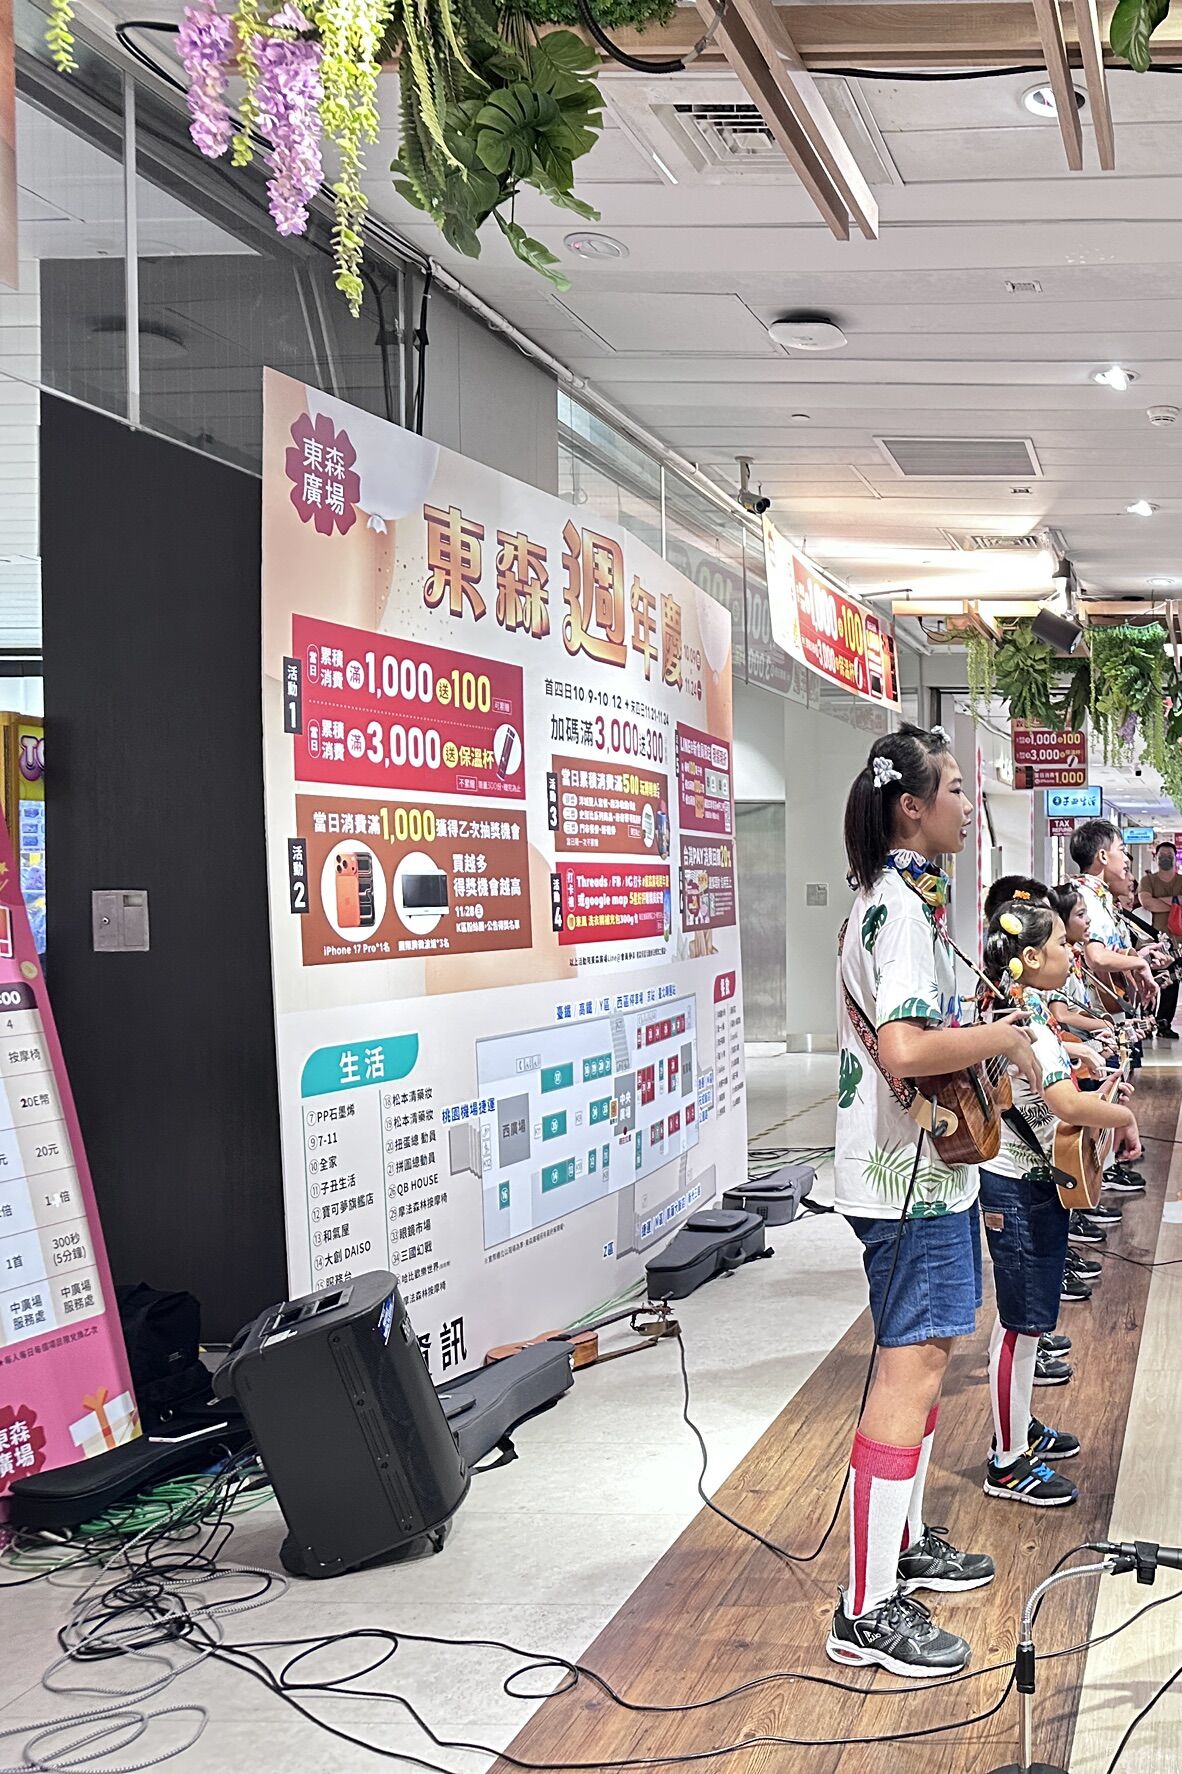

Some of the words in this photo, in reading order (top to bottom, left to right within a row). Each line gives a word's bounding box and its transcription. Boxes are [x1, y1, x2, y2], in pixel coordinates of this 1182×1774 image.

[303, 437, 346, 480] 東森
[302, 472, 345, 516] 廣場
[423, 502, 684, 693] 東森週年慶
[841, 604, 864, 656] 100
[321, 646, 343, 668] 累積
[321, 669, 343, 690] 消費
[365, 651, 434, 703] 1,000
[452, 669, 491, 713] 100
[322, 720, 344, 739] 累積
[1031, 734, 1057, 745] 1,000
[1062, 733, 1081, 744] 100
[322, 742, 344, 761] 消費
[367, 721, 441, 769] 3,000
[459, 745, 494, 770] 保溫杯
[1030, 749, 1060, 761] 3,000
[1055, 772, 1084, 784] 1,000
[453, 854, 488, 874] 買越多
[453, 877, 521, 898] 得獎機會越高
[576, 875, 608, 888] Threads
[323, 945, 352, 957] iPhone
[353, 944, 362, 954] 17
[6, 1020, 14, 1029] 4
[8, 1048, 41, 1064] 按摩椅
[339, 1046, 385, 1084] 生活
[442, 1097, 495, 1124] 桃園機場捷運
[502, 1119, 526, 1138] 西廣場
[318, 1133, 338, 1147] 7-11
[35, 1144, 60, 1158] 20元
[319, 1156, 338, 1172] 全家
[320, 1174, 356, 1196] 子丑生活
[397, 1182, 409, 1196] QB
[411, 1173, 439, 1191] HOUSE
[323, 1223, 350, 1243] 和氣屋
[399, 1219, 431, 1240] 眼鏡市場
[52, 1232, 81, 1250] 300秒
[6, 1255, 24, 1270] 1首
[53, 1245, 87, 1267] (5分鐘)
[324, 1248, 343, 1268] 大創
[345, 1240, 371, 1259] DAISO
[61, 1279, 92, 1298] 中廣場
[10, 1294, 43, 1314] 中廣場
[64, 1294, 95, 1314] 服務處
[13, 1309, 47, 1330] 服務處
